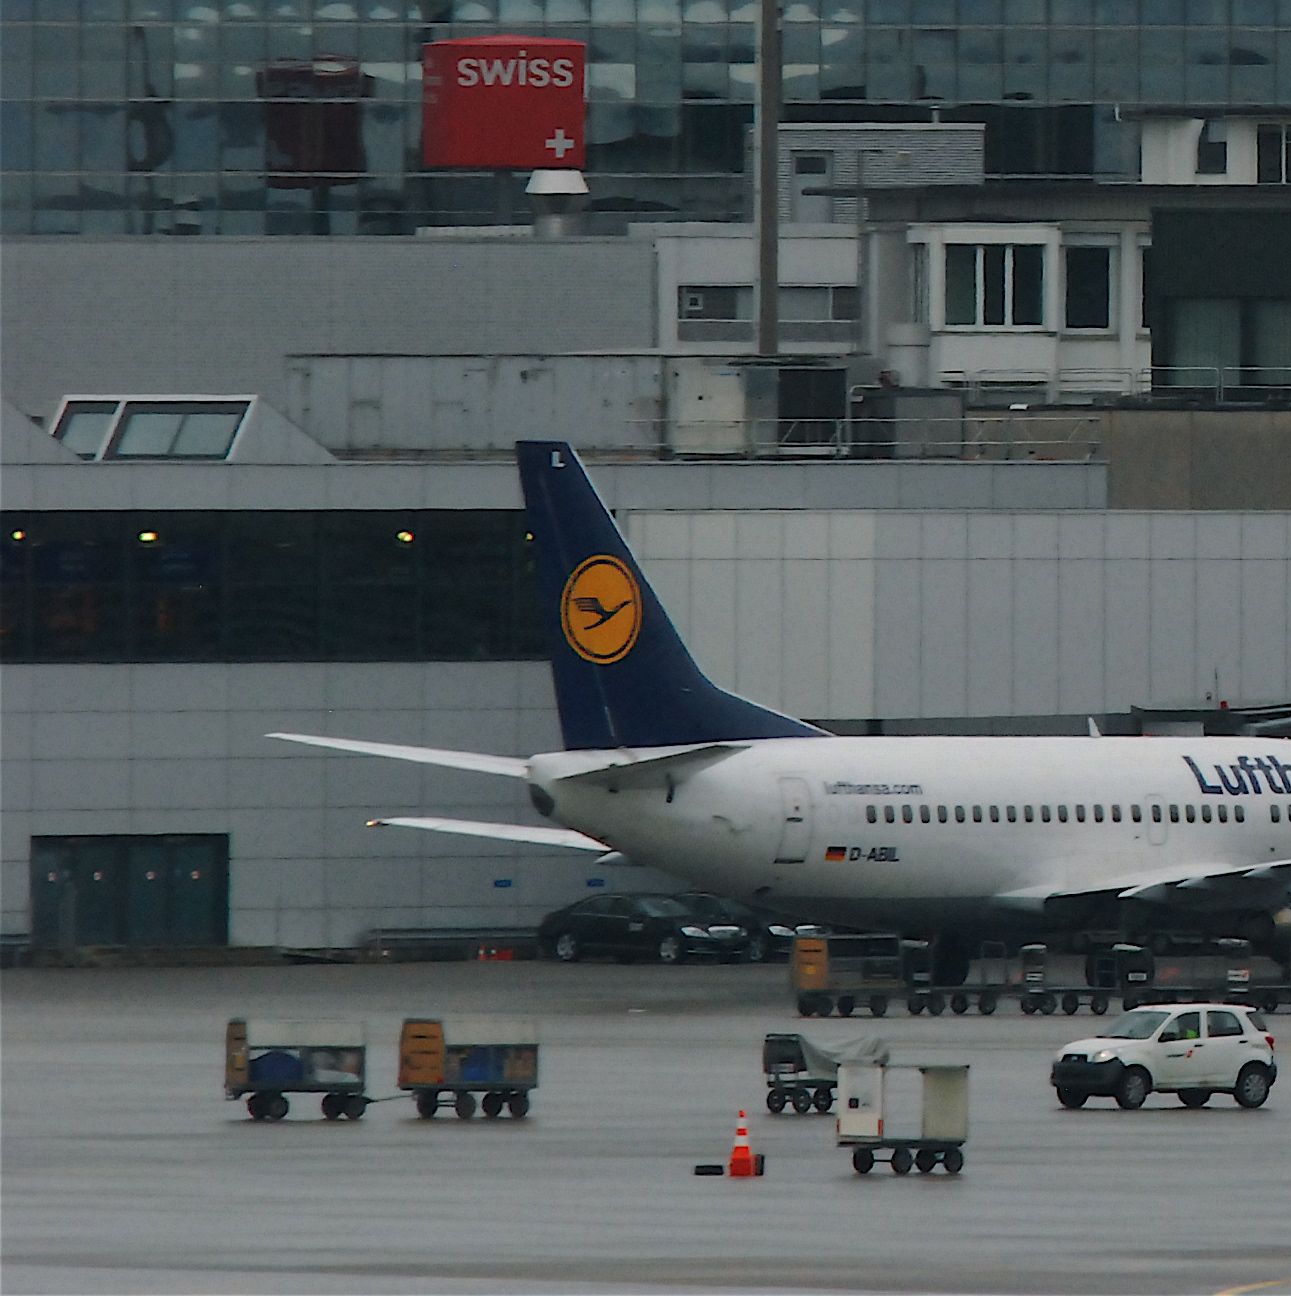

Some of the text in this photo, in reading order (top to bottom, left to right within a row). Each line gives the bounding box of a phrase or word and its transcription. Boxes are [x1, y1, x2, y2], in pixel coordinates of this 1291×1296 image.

[457, 50, 574, 87] swiss
[551, 451, 566, 468] L
[823, 780, 924, 795] lufthansa.com
